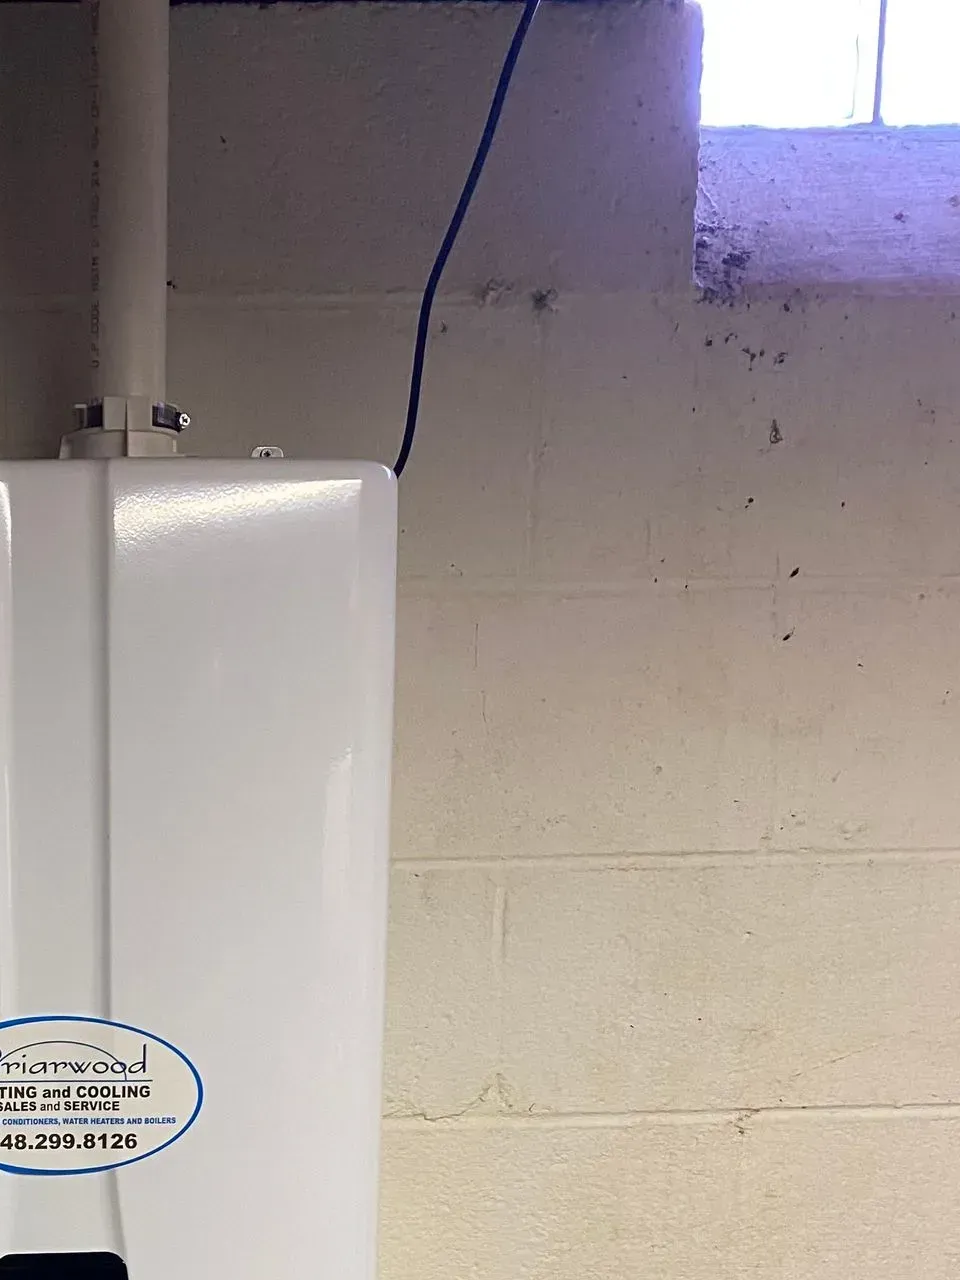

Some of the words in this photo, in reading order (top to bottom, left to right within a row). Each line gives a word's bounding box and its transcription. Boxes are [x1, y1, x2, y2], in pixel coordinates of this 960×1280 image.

[42, 1086, 71, 1098] and
[76, 1085, 151, 1098] COOLING
[40, 1101, 60, 1111] and
[64, 1101, 120, 1111] SERVICE
[2, 1117, 61, 1126] CONDITIONERS,
[62, 1117, 88, 1125] WATER
